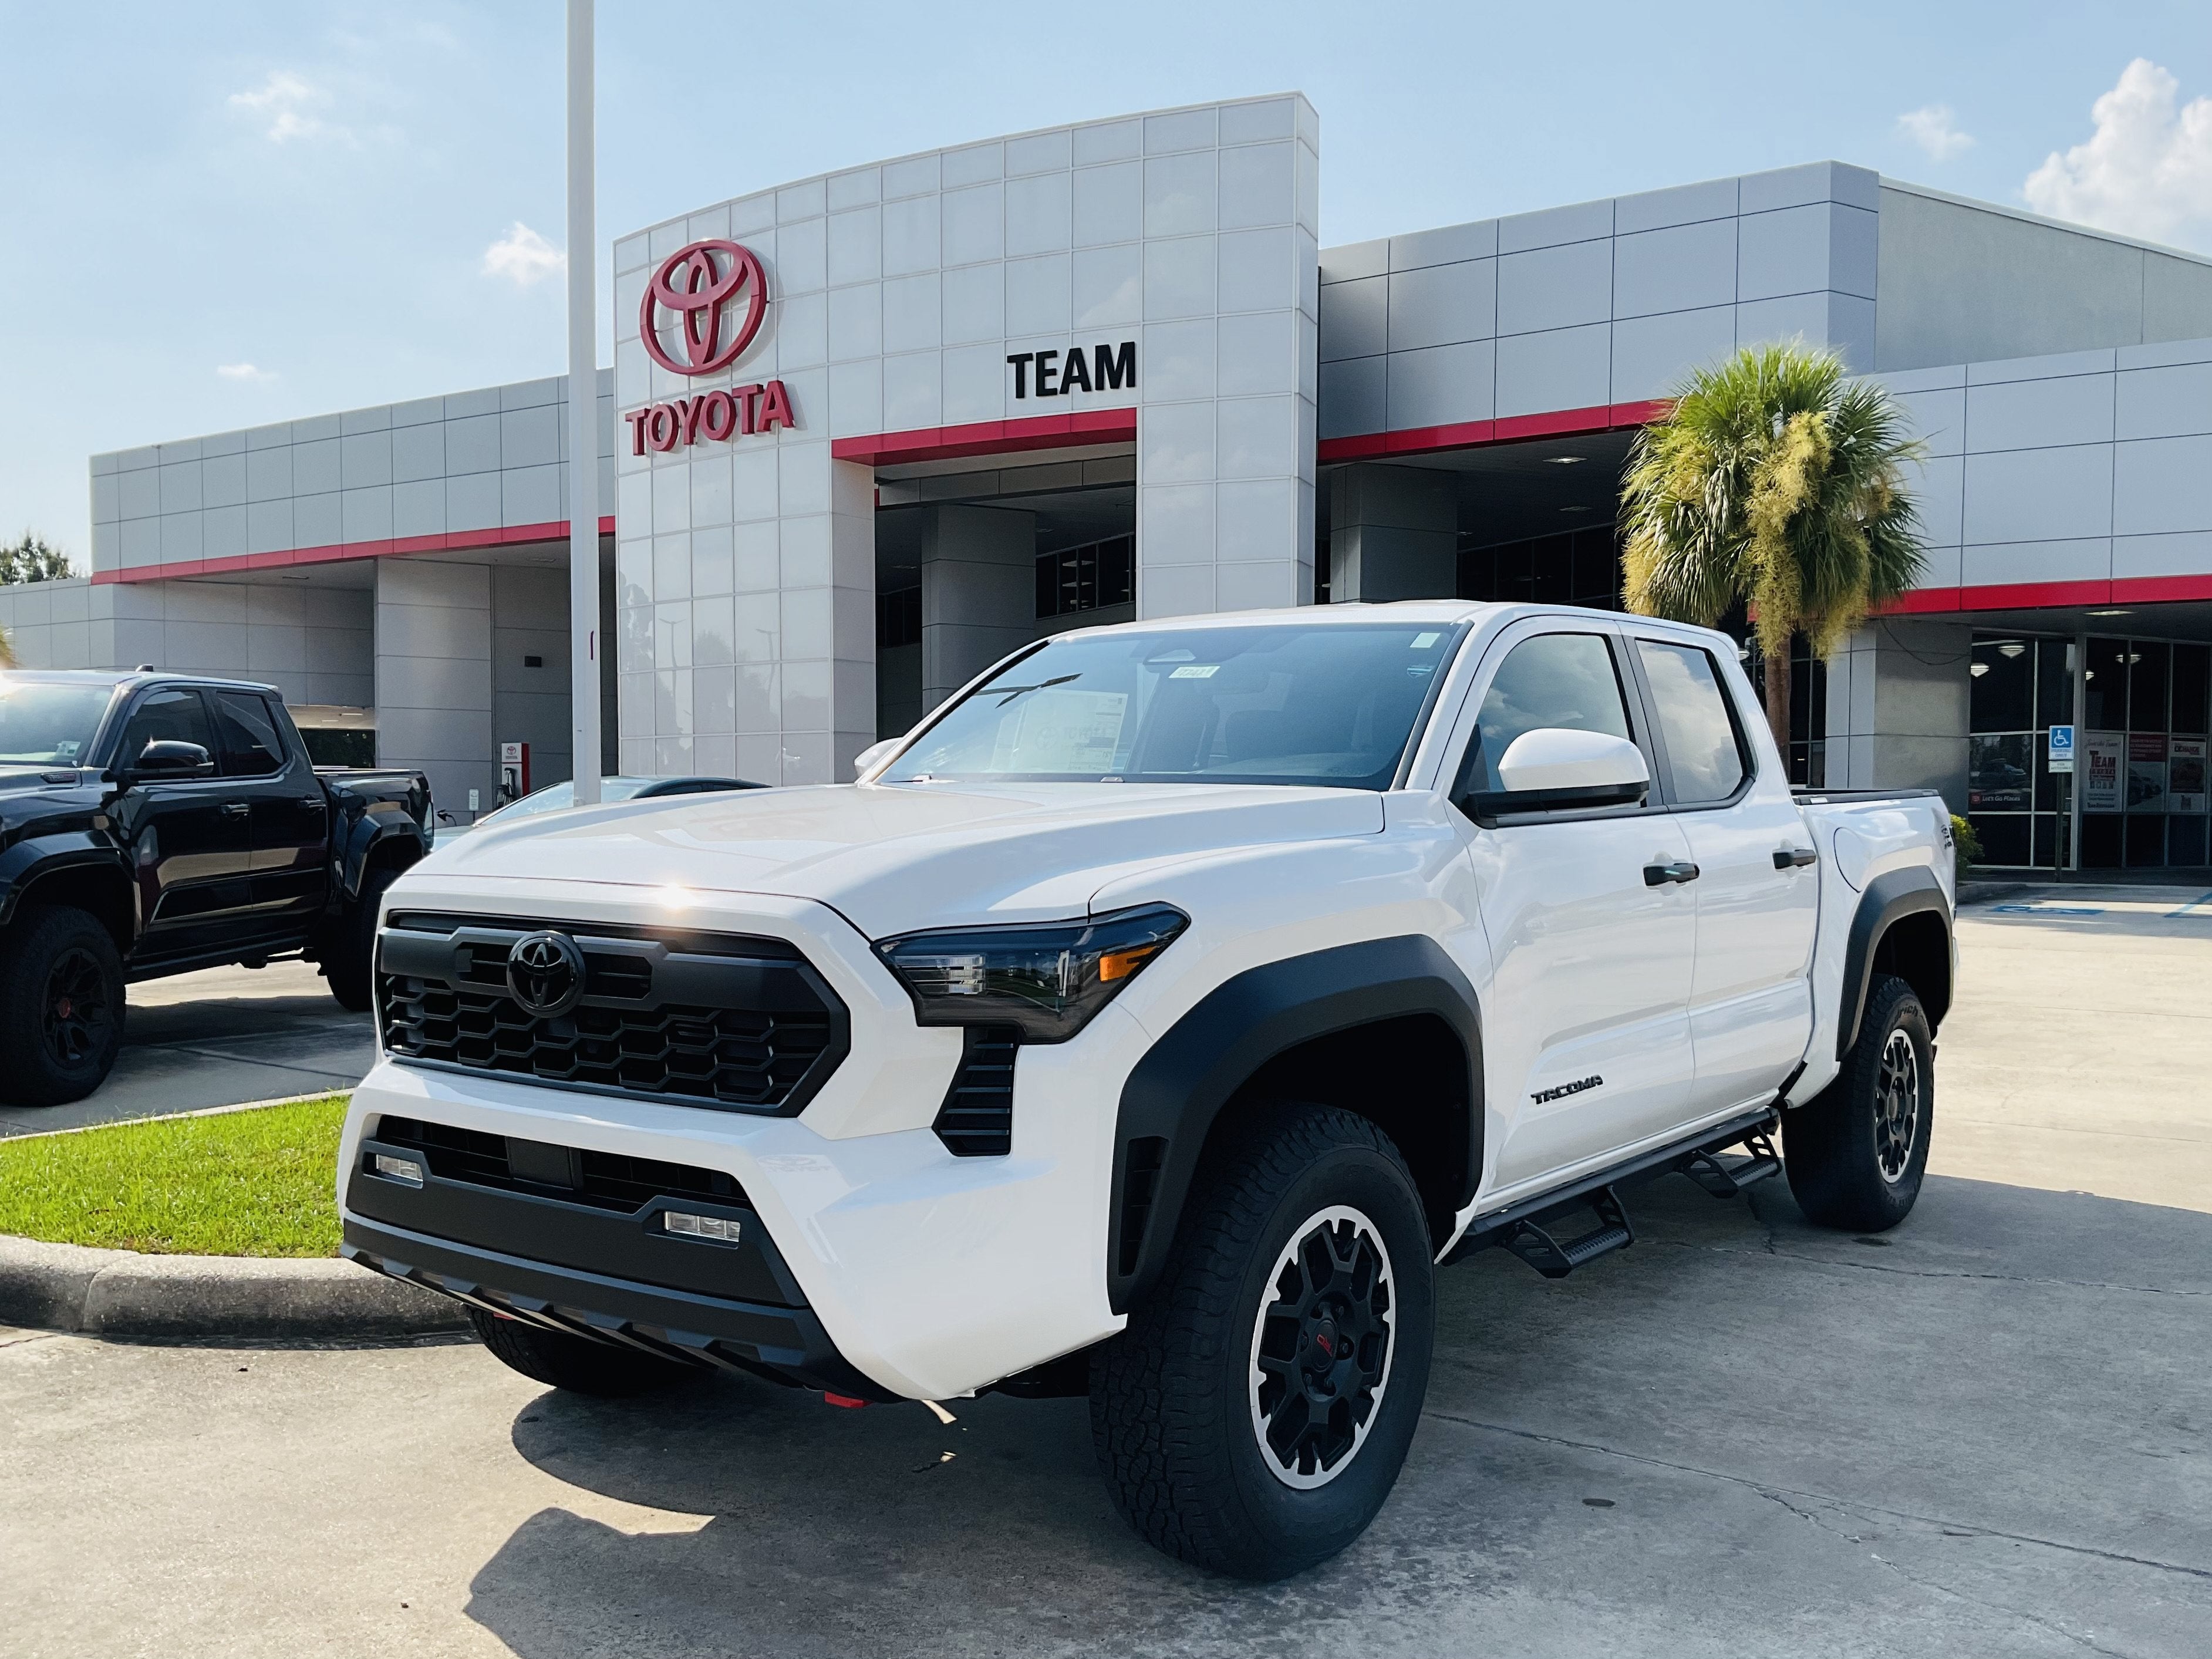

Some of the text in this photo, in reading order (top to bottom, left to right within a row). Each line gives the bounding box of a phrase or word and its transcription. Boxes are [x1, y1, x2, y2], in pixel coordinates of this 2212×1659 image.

[1007, 341, 1136, 399] TEAM
[625, 380, 796, 456] TOYOTA
[1530, 1074, 1603, 1104] TACOMA
